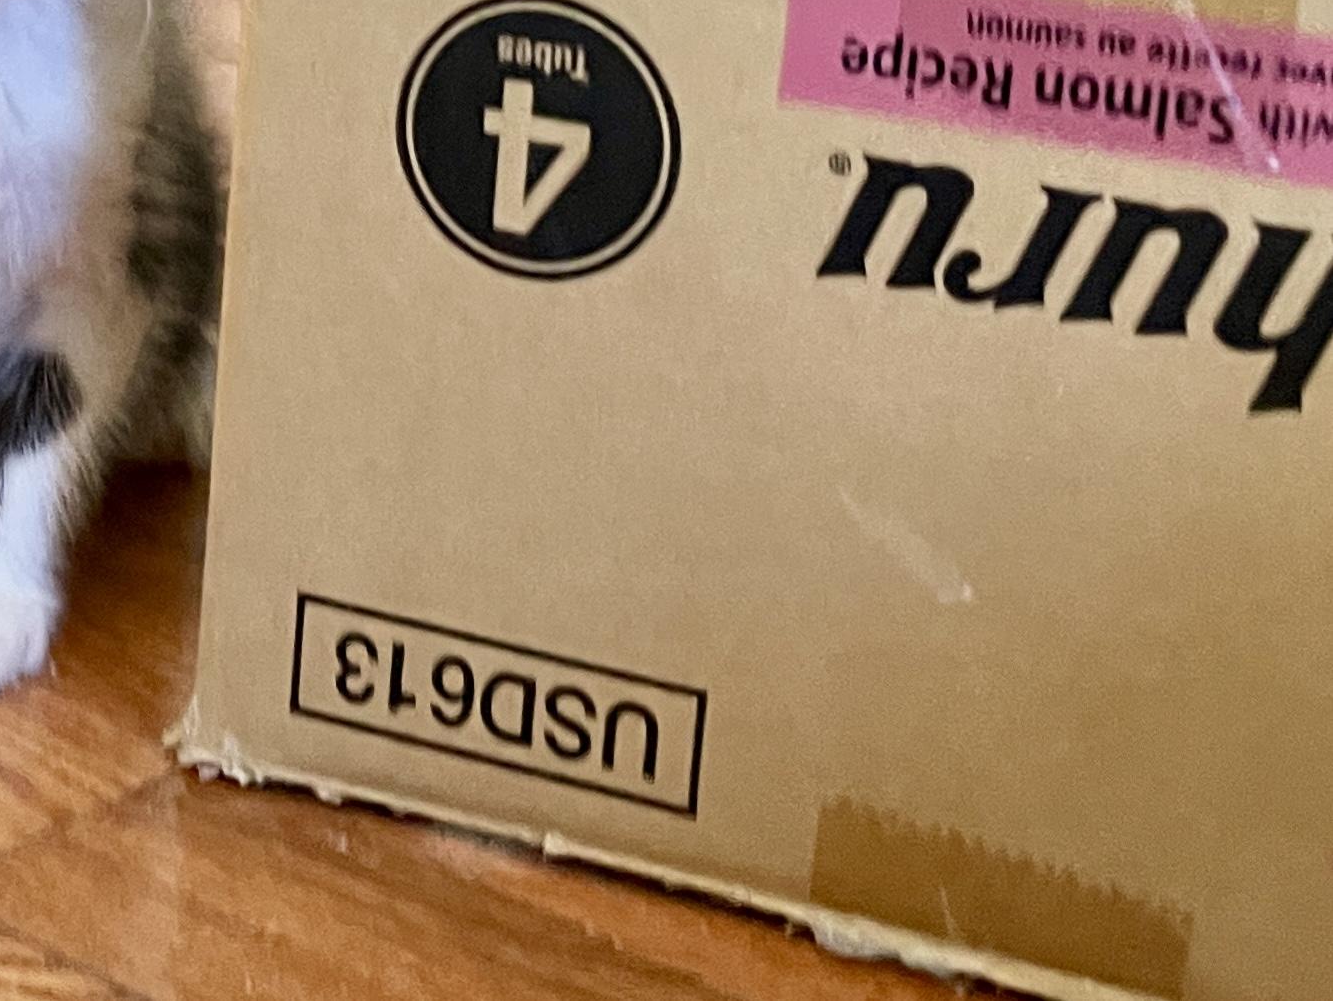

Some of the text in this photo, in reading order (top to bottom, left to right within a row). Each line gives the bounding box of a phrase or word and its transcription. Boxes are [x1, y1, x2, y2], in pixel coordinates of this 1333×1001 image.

[839, 25, 1014, 112] Recipe
[1035, 65, 1234, 146] Salmon
[482, 78, 592, 237] 4
[333, 631, 660, 785] USD613
